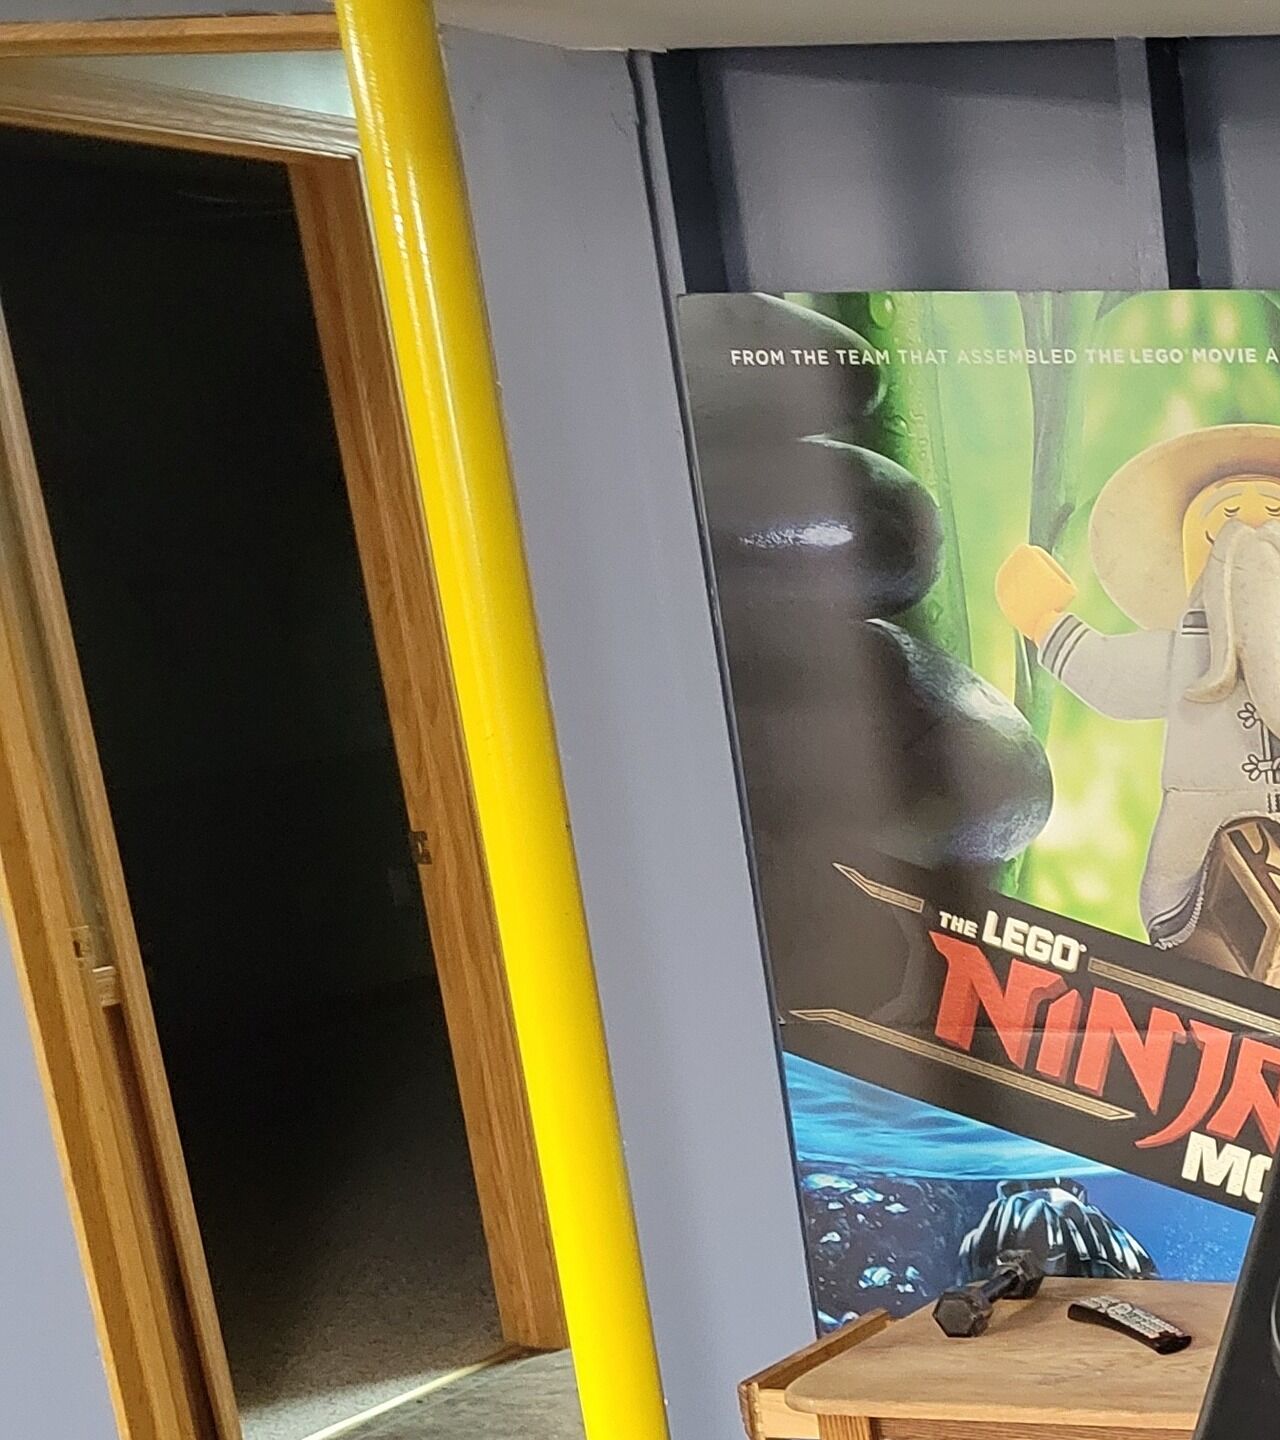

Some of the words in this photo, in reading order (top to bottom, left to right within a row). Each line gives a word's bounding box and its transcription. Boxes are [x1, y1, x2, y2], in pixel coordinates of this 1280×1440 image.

[730, 349, 785, 366] FROM
[791, 349, 829, 366] THE
[835, 348, 891, 366] TEAM
[898, 348, 949, 366] THAT
[957, 348, 1078, 365] ASSEMBLED
[1086, 348, 1125, 365] THE
[1192, 348, 1258, 364] MOVIE
[939, 911, 978, 938] THE
[981, 910, 1081, 972] LEGO
